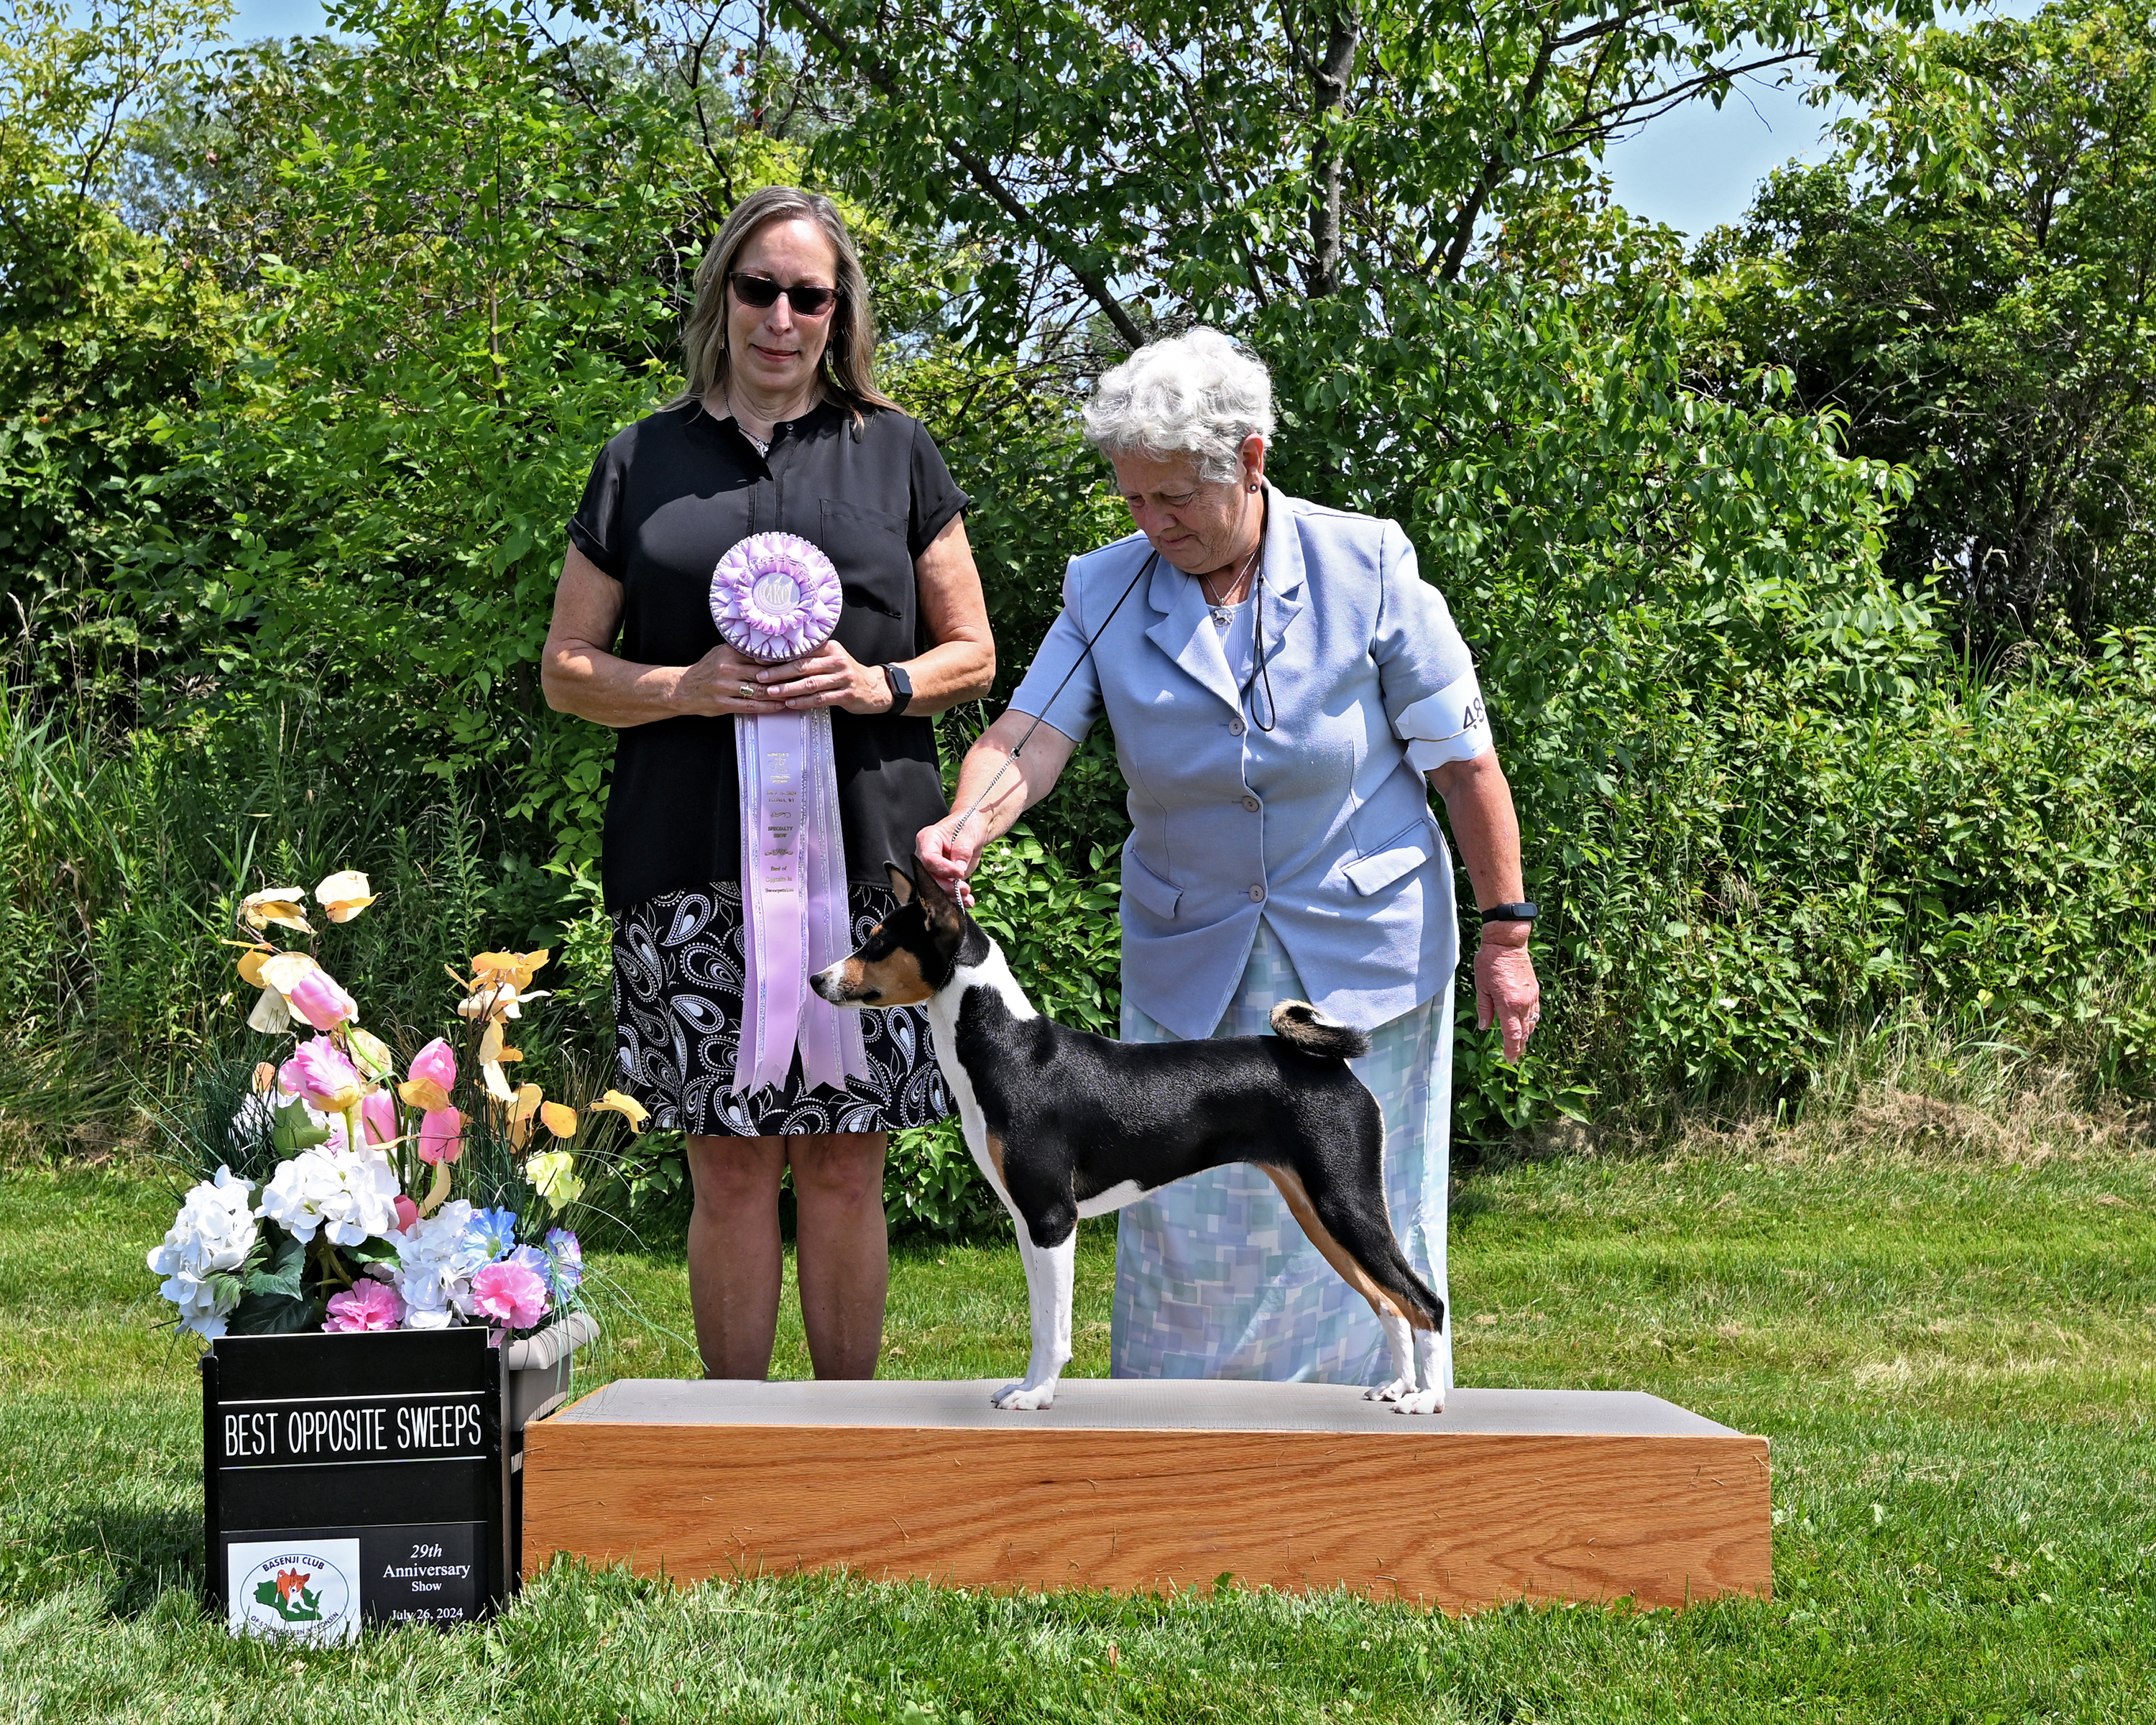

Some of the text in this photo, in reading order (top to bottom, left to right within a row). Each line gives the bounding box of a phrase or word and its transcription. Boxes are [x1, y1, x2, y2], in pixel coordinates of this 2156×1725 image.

[1462, 696, 1484, 730] 48
[225, 1404, 482, 1456] BEST OPPOSITE SWEEPS
[410, 1543, 443, 1559] 29th
[262, 1555, 325, 1572] BASENJI CLUB
[382, 1563, 471, 1579] Anniversary
[411, 1581, 443, 1592] Show
[391, 1607, 464, 1622] July 26, 2024
